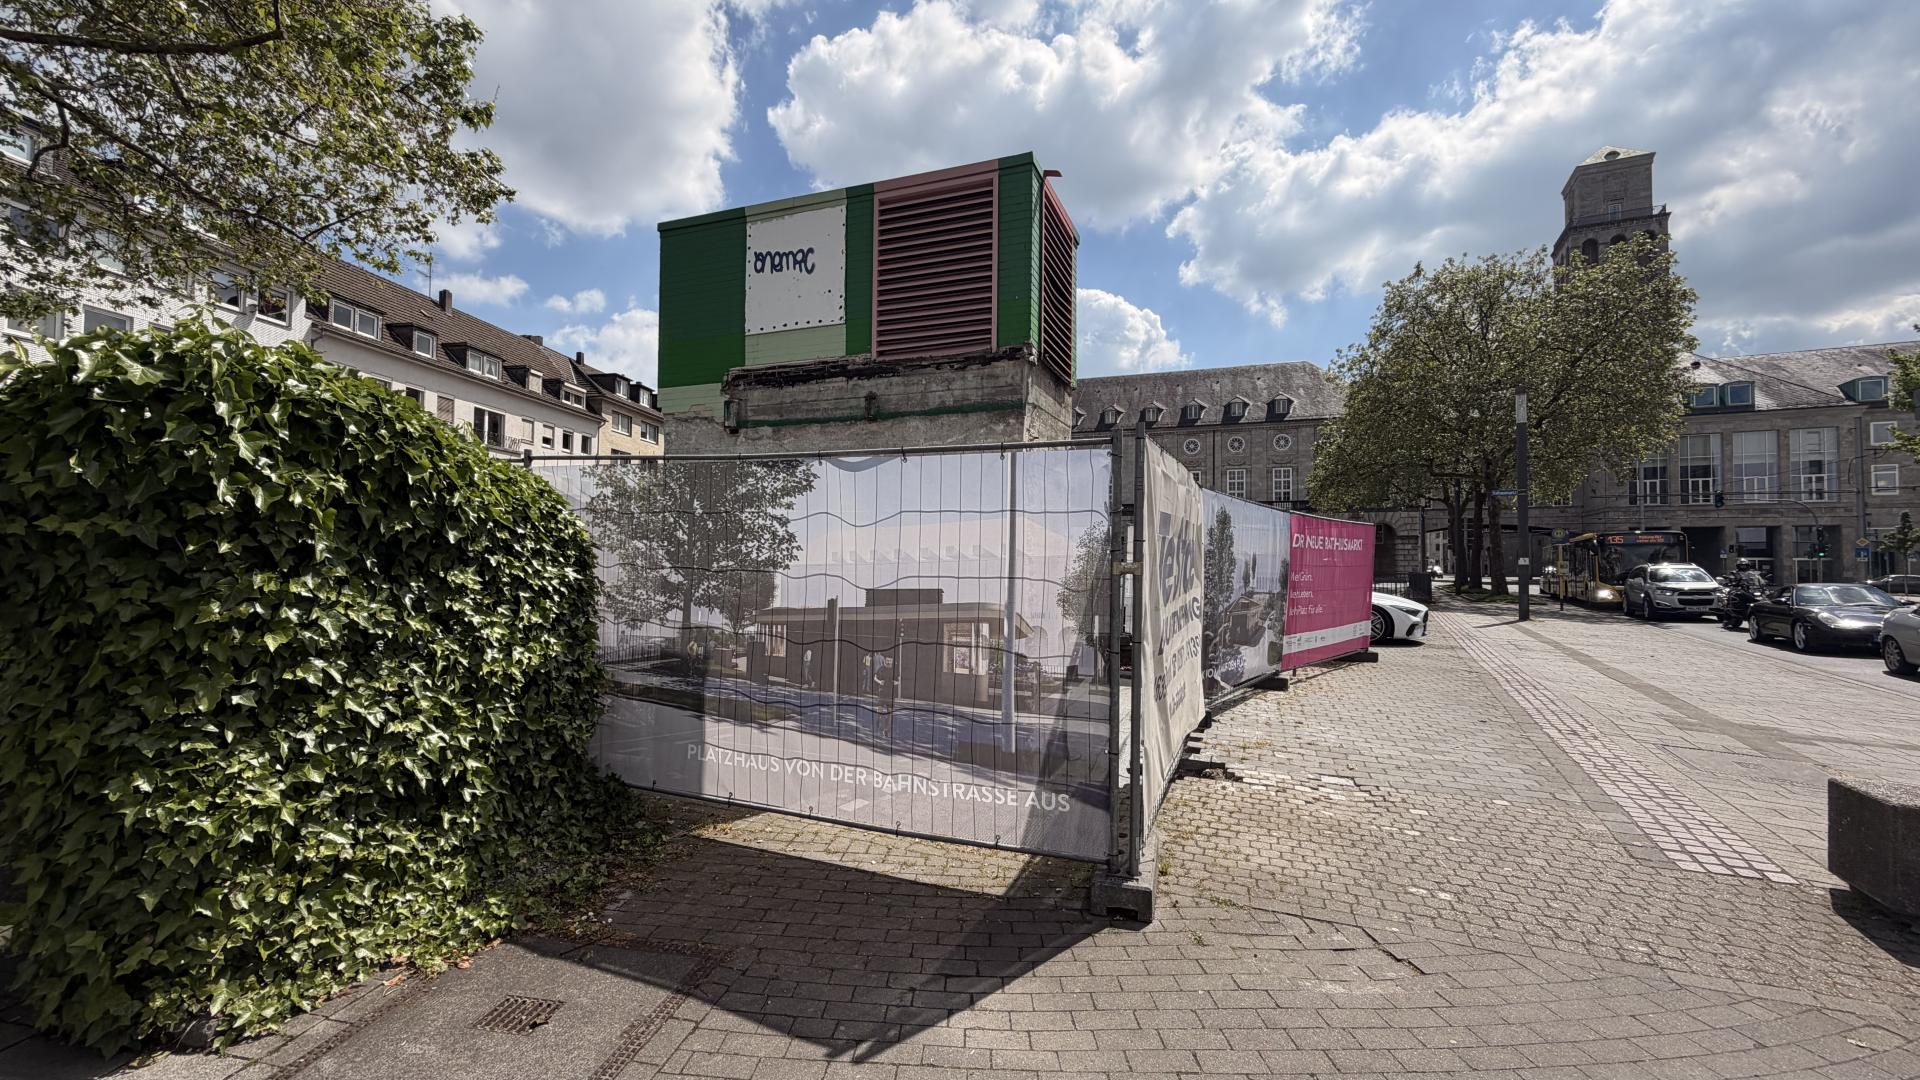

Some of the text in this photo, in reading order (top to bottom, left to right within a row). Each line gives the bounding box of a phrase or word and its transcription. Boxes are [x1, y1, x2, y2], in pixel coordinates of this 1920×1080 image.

[1607, 536, 1624, 544] 135
[688, 744, 1071, 812] PLATZHAUS VON DER BAHNSTRASSE AUS
